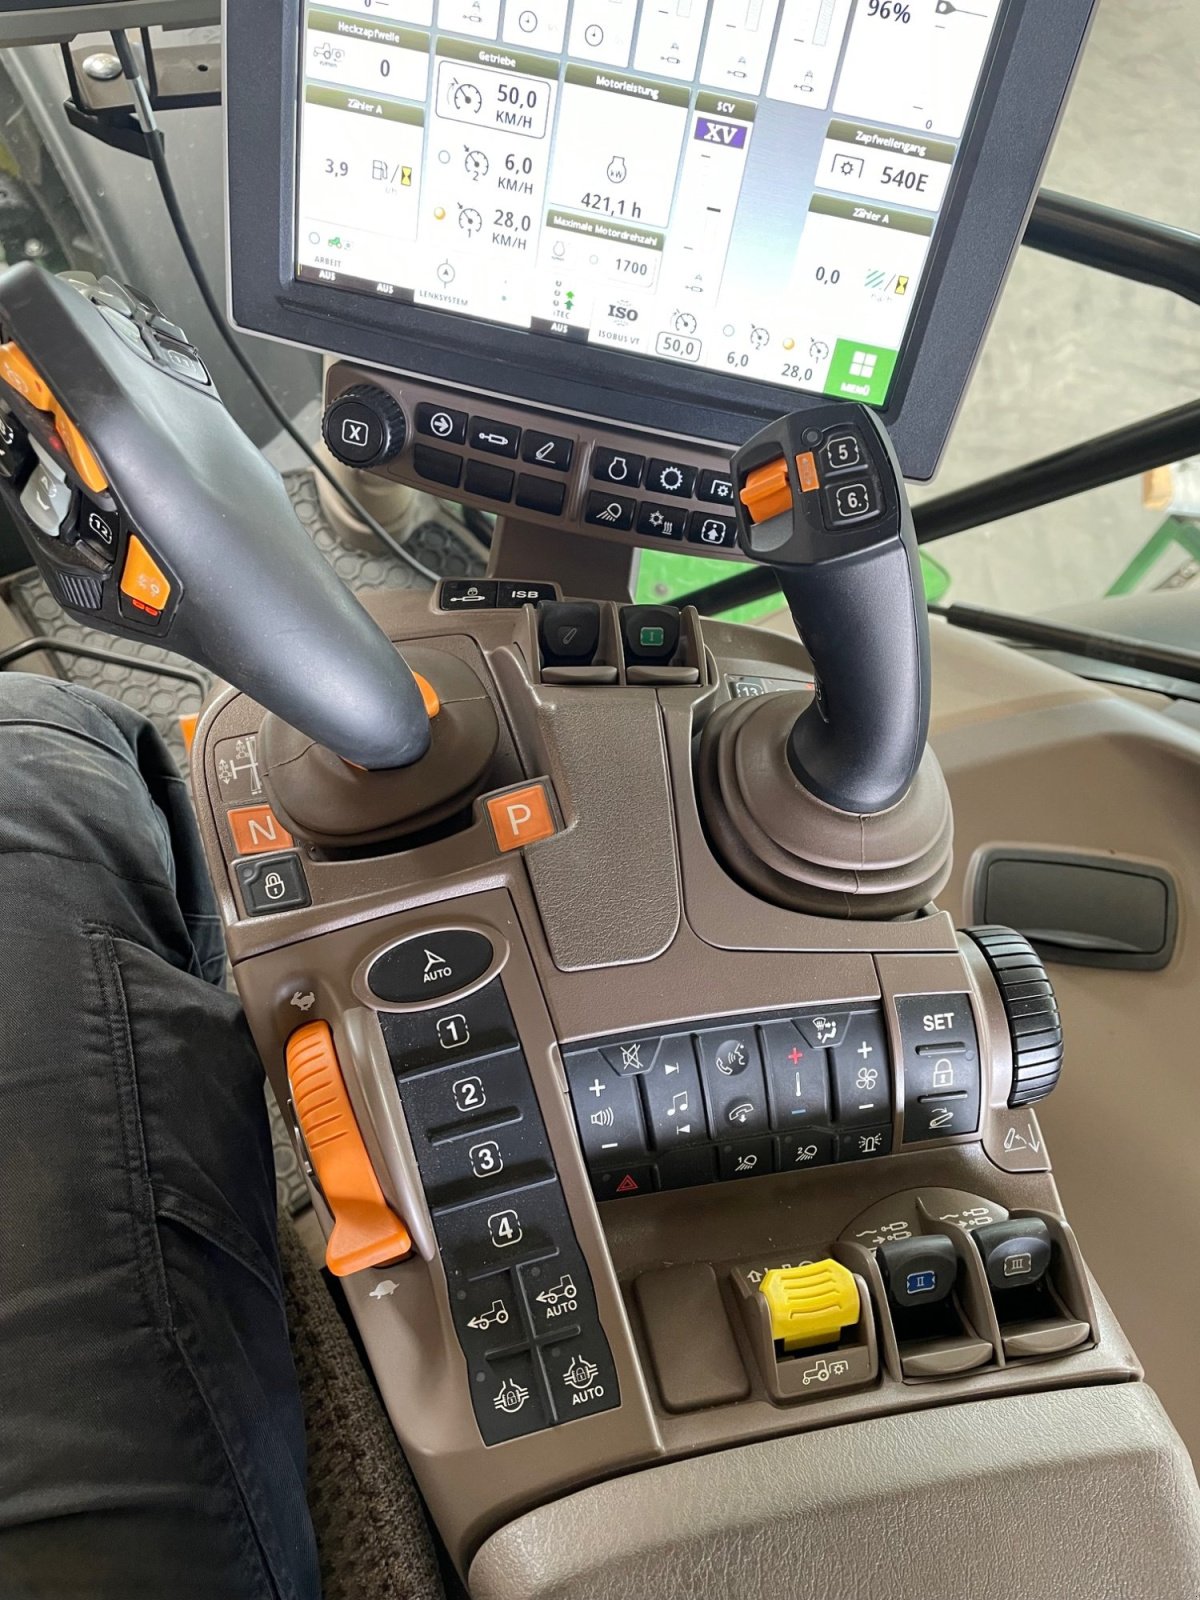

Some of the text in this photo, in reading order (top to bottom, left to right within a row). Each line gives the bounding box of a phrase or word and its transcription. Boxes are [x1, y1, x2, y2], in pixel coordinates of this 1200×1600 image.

[866, 0, 911, 24] 96%
[338, 20, 400, 43] Heckzapfwelle
[380, 59, 390, 77] 0
[478, 50, 517, 67] Getriebe
[497, 84, 537, 109] 50,0
[596, 75, 659, 100] Motorleistung
[716, 101, 736, 114] SCV
[496, 110, 532, 129] KM/H
[925, 119, 933, 130] 0
[703, 122, 739, 145] XV
[856, 130, 927, 157] Zapfwellengang
[325, 158, 348, 177] 3,9
[505, 153, 532, 174] 6,0
[497, 177, 533, 195] KM/H
[880, 166, 928, 192] 540E
[581, 192, 641, 218] 421,1 h
[493, 209, 531, 232] 28,0
[553, 215, 658, 246] Maximale Motordrehzahl
[492, 232, 527, 250] KM/H
[314, 255, 342, 267] ARBEIT
[616, 258, 647, 275] 1700
[319, 269, 336, 281] AUS
[815, 266, 840, 284] 0,0
[376, 282, 394, 294] AUS
[419, 289, 468, 306] LENKSYSTEM
[608, 304, 639, 321] ISO
[550, 322, 568, 333] AUS
[598, 330, 628, 343] ISOBUS
[662, 336, 694, 355] 50,0
[727, 351, 749, 367] 6,0
[781, 363, 813, 381] 28,0
[838, 444, 849, 460] 5
[94, 519, 108, 537] 12
[511, 589, 539, 600] ISB
[506, 803, 532, 836] P
[248, 815, 277, 845] N
[423, 966, 452, 984] AUTO
[446, 1021, 459, 1041] 1
[922, 1013, 955, 1032] SET
[461, 1083, 479, 1105] 2
[478, 1148, 495, 1170] 3
[498, 1217, 513, 1239] 4
[545, 1300, 578, 1320] AUTO
[572, 1385, 605, 1406] AUTO
